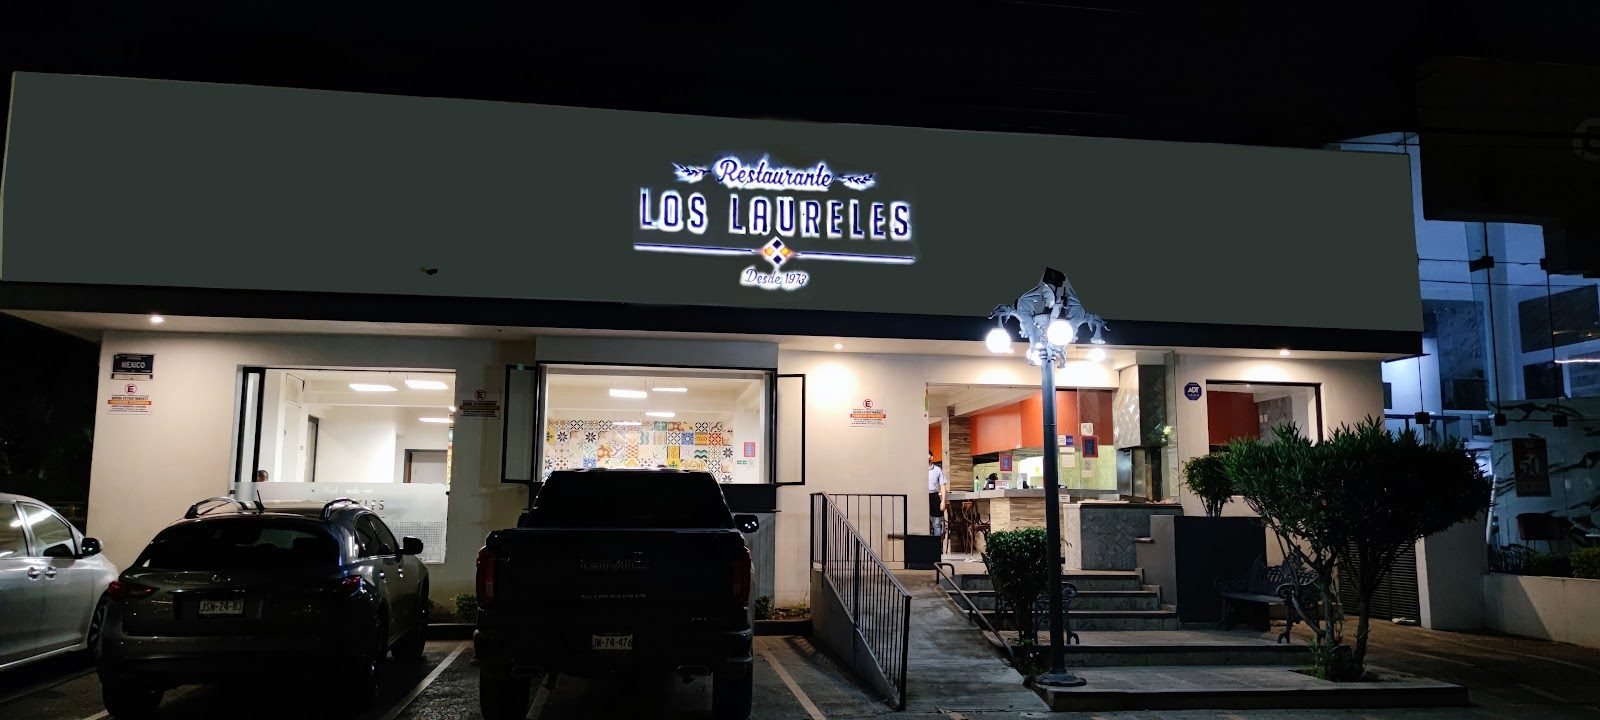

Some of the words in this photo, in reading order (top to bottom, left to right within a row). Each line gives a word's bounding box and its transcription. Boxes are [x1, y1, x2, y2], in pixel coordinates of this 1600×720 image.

[717, 158, 835, 189] Restaurante
[640, 192, 706, 229] LOS
[731, 193, 909, 237] LAURELES
[744, 268, 782, 286] Desde
[785, 271, 808, 287] 1973
[1187, 386, 1200, 394] ADT
